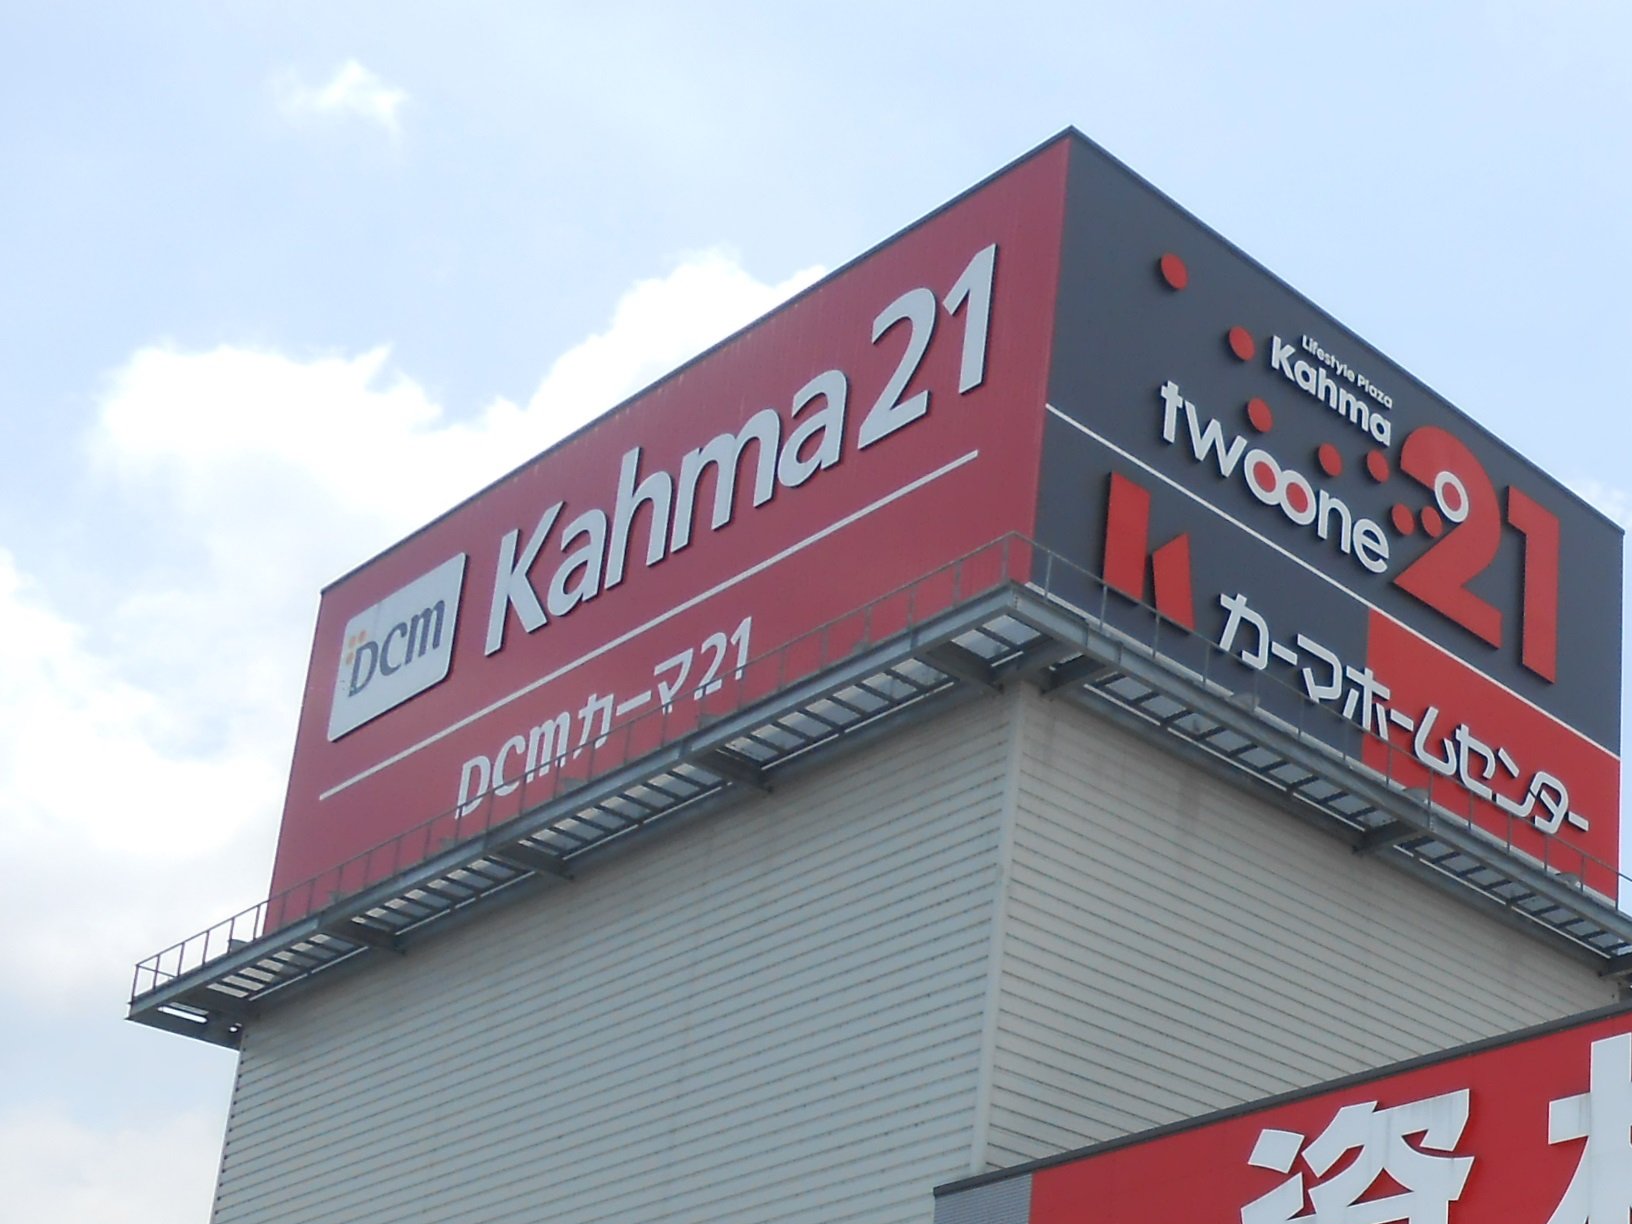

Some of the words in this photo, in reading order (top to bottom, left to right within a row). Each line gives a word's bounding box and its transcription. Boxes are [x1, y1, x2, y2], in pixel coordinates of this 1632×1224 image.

[1271, 336, 1392, 447] Kahma
[1301, 334, 1355, 383] Lifestyle
[1357, 372, 1393, 409] Plaza
[1160, 379, 1390, 575] twoone
[1394, 425, 1561, 684] 21
[1218, 591, 1590, 835] カーマホームセンター
